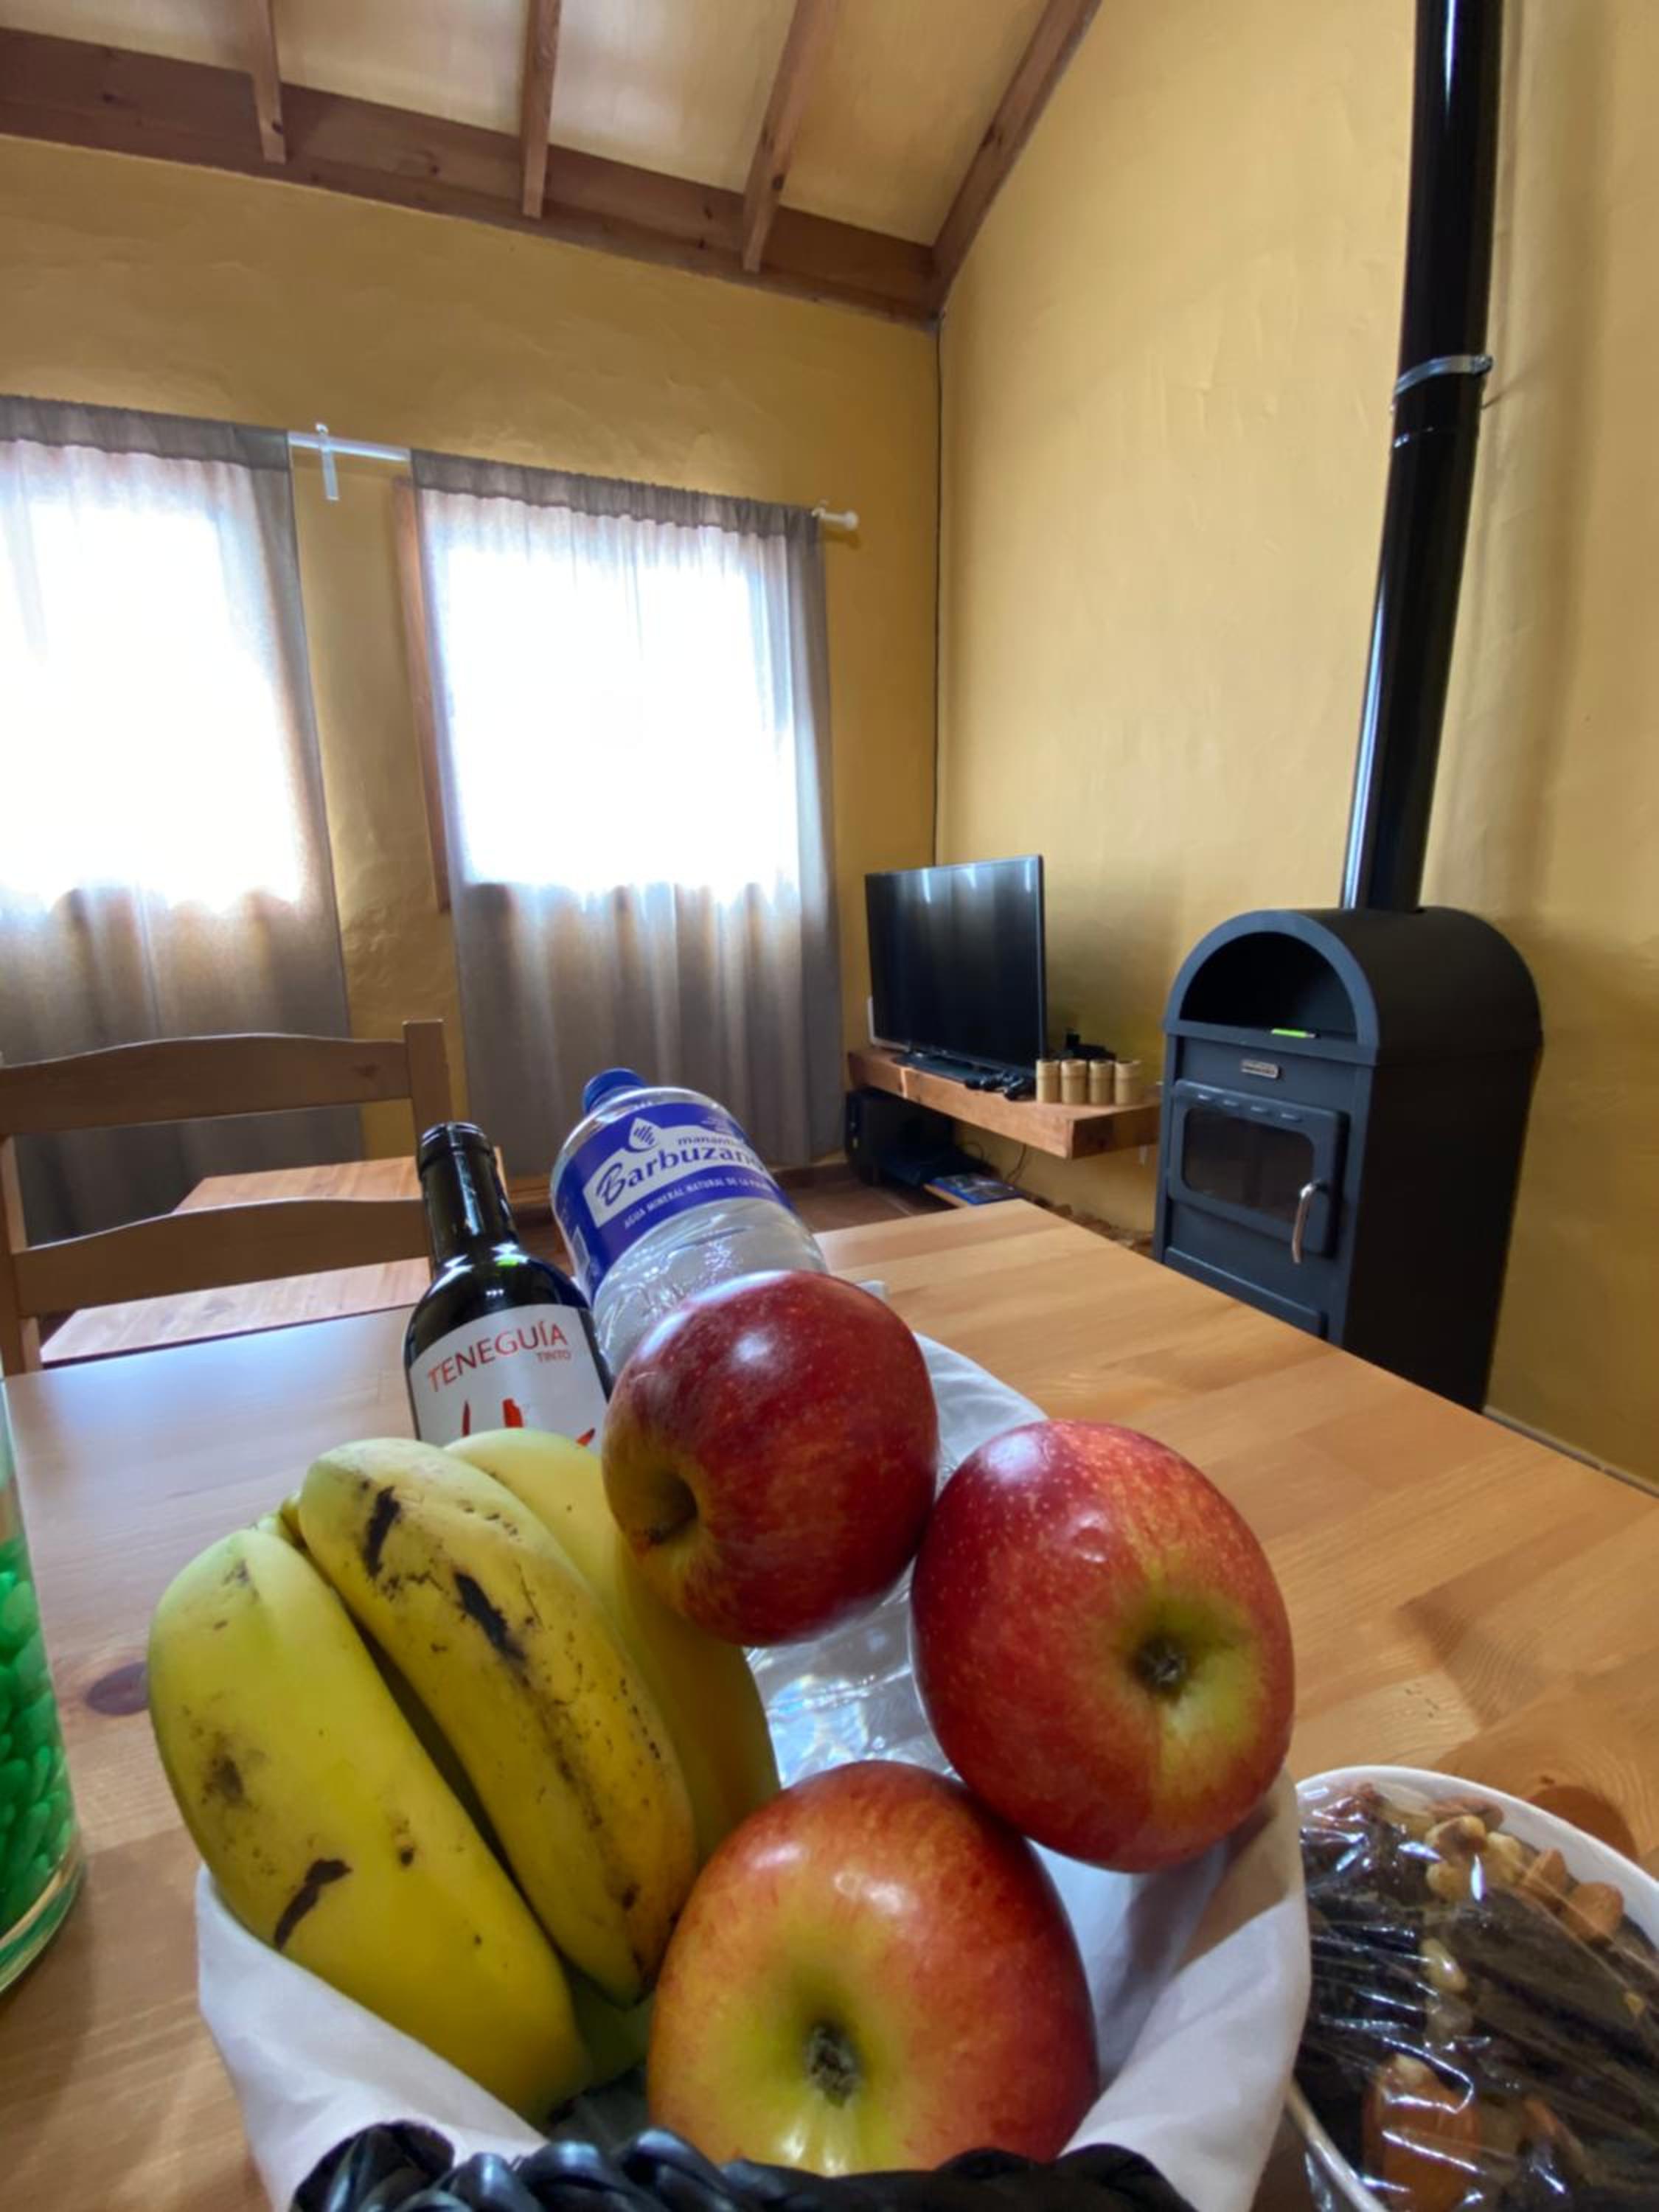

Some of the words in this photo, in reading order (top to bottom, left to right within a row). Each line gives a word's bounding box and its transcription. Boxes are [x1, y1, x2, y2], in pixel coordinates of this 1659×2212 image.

[647, 1188, 685, 1211] MINERAL
[686, 1179, 724, 1192] NATURAL
[427, 1320, 567, 1393] TENEGUÍA
